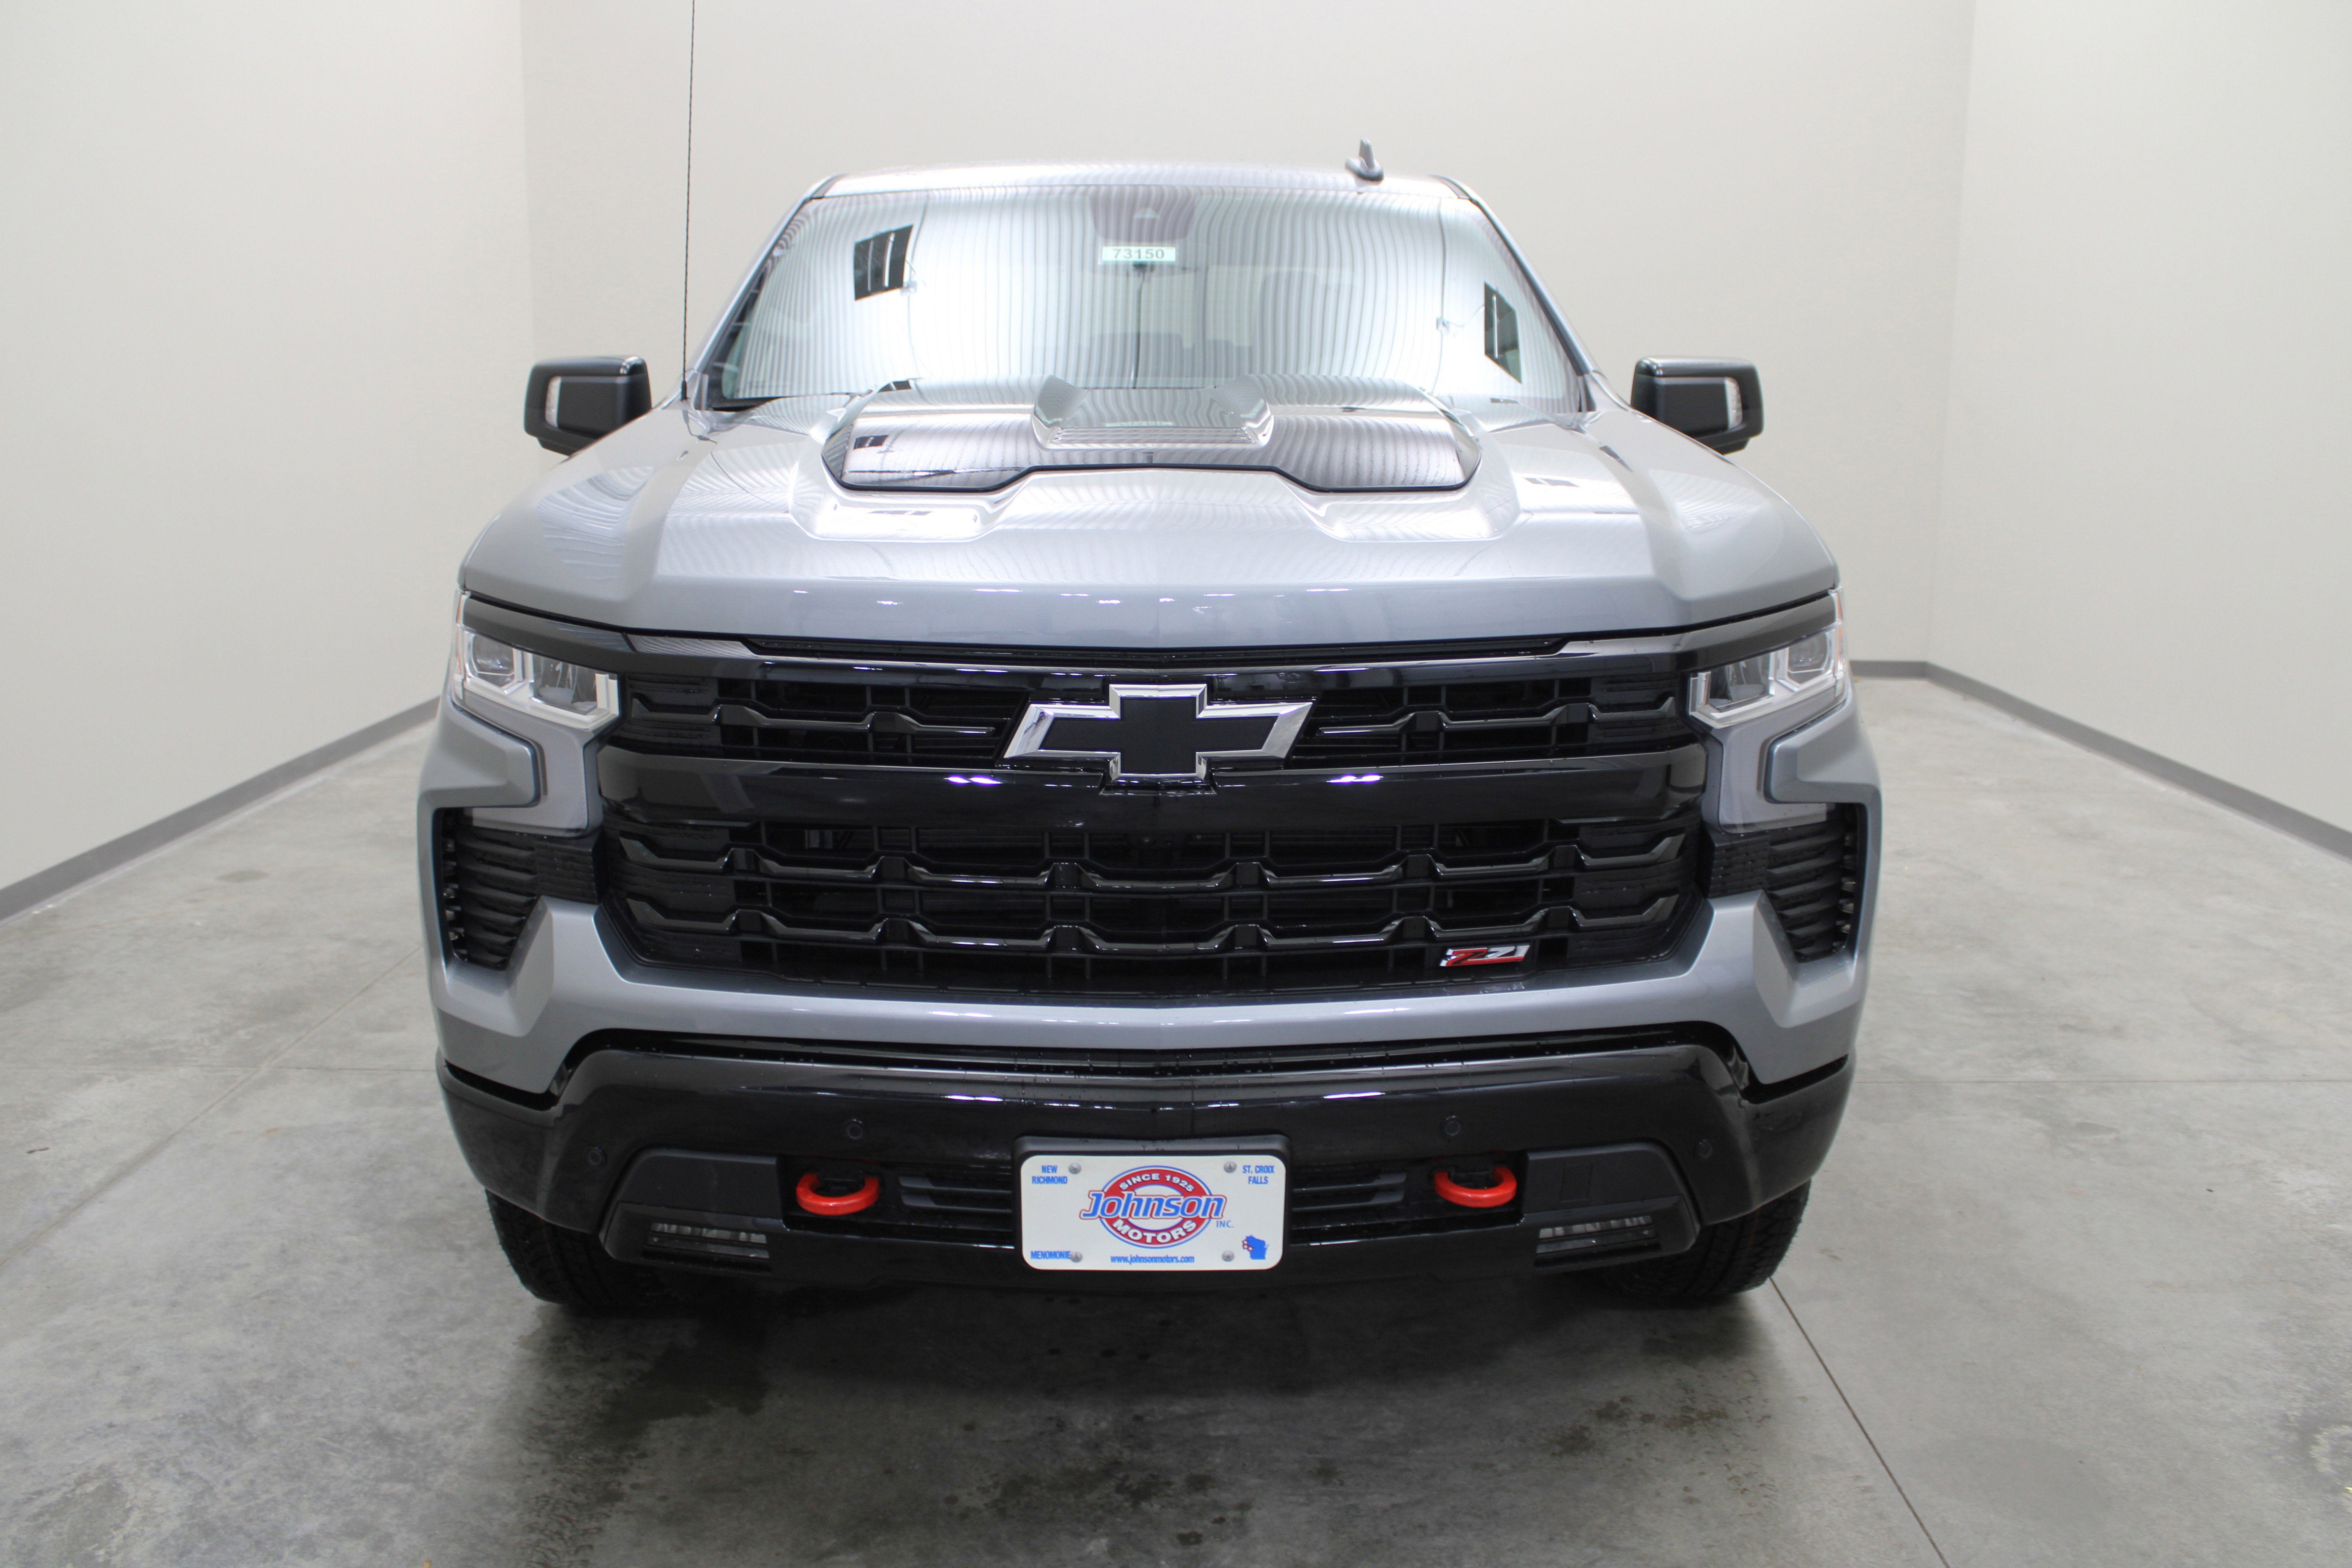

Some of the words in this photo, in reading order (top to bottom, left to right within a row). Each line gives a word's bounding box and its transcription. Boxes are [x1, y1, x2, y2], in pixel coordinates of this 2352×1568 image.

[1113, 249, 1164, 259] 73150
[1440, 945, 1530, 967] Z71
[1119, 1174, 1160, 1191] SINCE
[1165, 1175, 1194, 1193] 1925
[1082, 1193, 1224, 1218] Johnson
[1112, 1220, 1196, 1243] MOTORS
[1031, 1251, 1071, 1260] MENOMONIE
[1110, 1255, 1194, 1265] www.johnsonmotors.com
